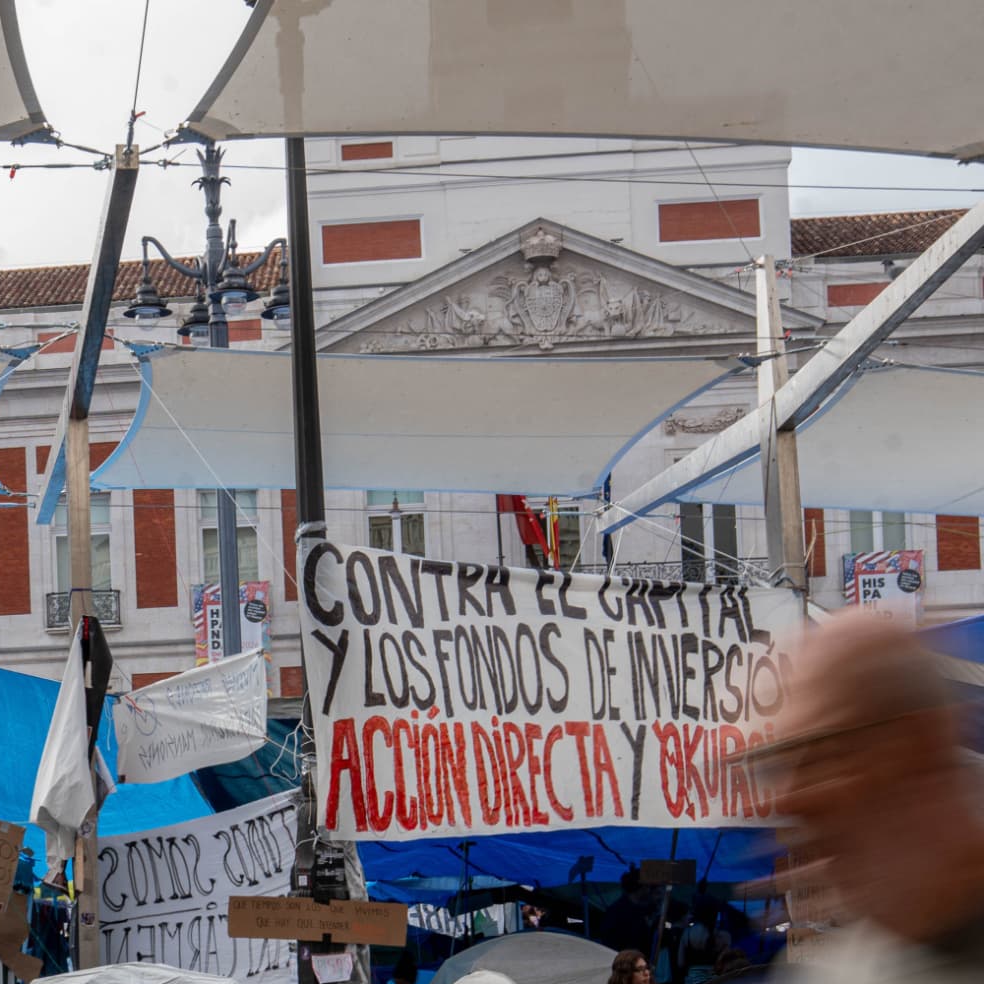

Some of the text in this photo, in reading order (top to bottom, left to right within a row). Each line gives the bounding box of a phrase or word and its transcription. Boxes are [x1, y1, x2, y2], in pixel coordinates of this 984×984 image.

[303, 541, 771, 644] CONTRA EL CAPITAL
[862, 578, 885, 588] HIS
[863, 589, 881, 599] PA
[311, 629, 349, 716] Y
[363, 628, 436, 711] LOS
[433, 622, 570, 717] FONDOS
[584, 627, 621, 721] DE
[325, 704, 472, 832] ACCIÓN
[471, 715, 624, 828] DIRECTA
[620, 721, 647, 821] Y
